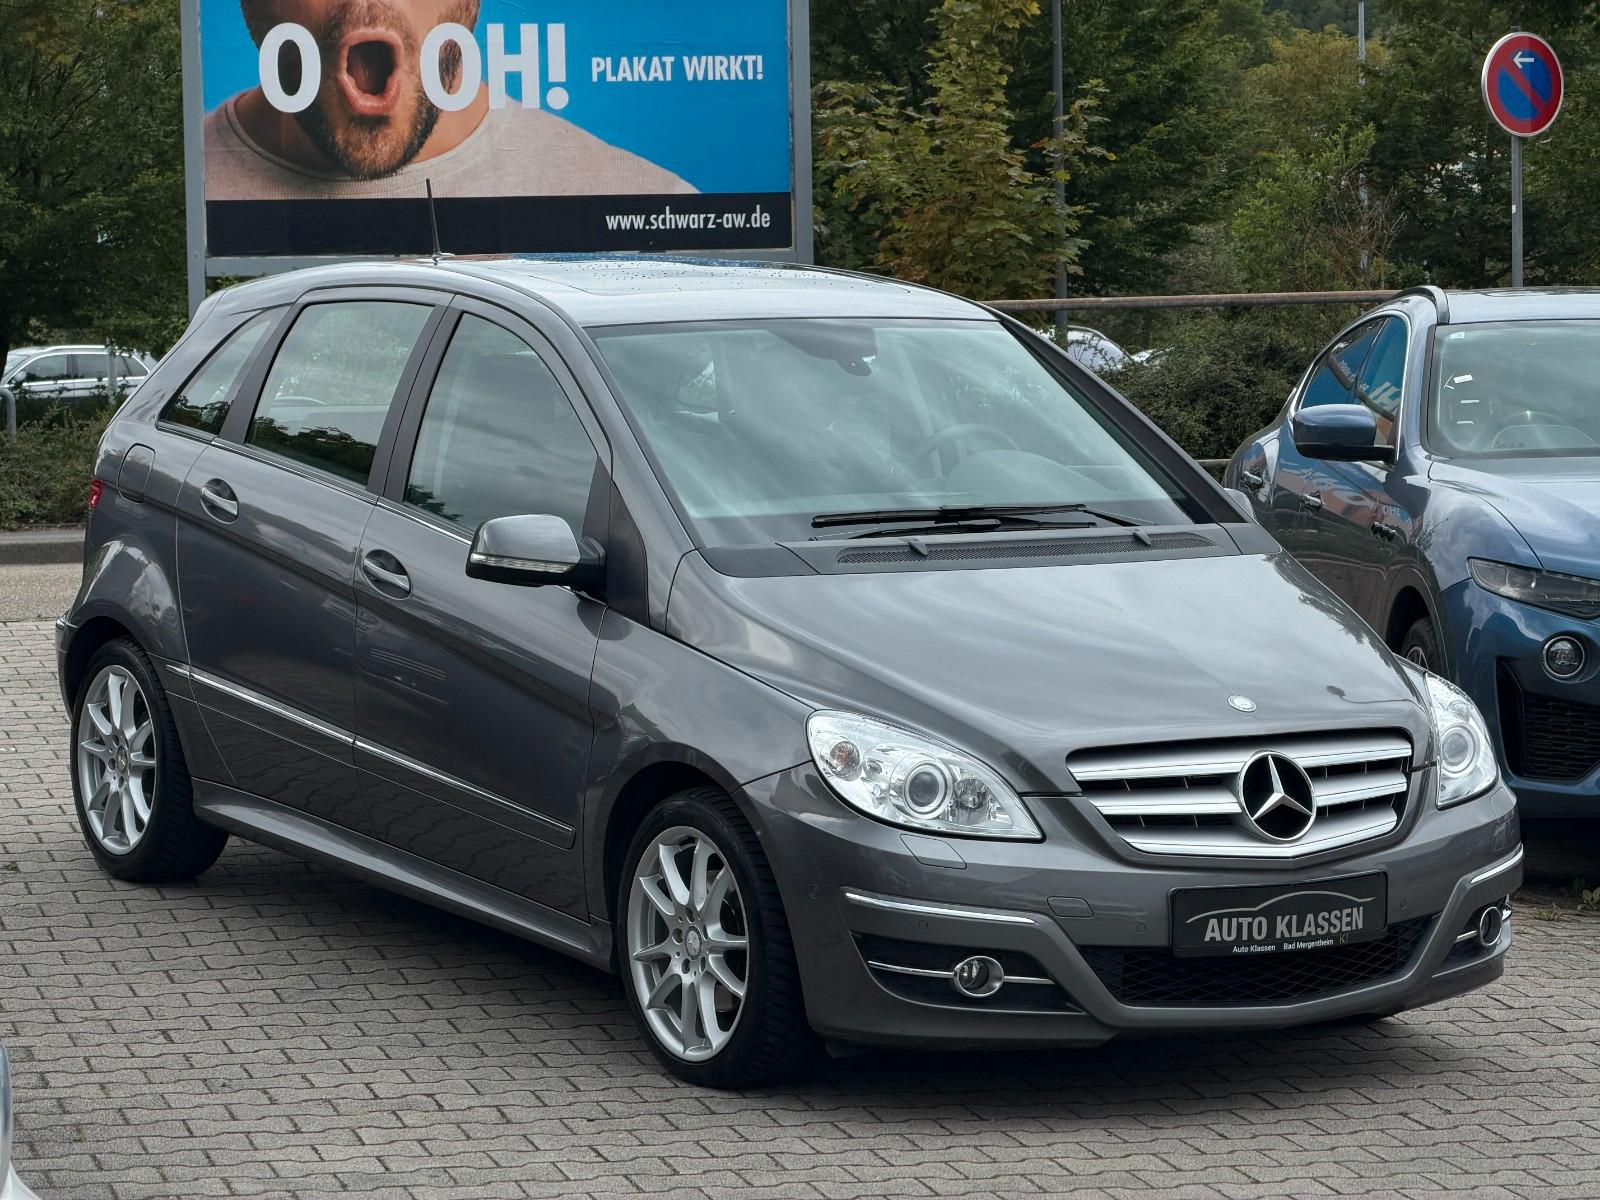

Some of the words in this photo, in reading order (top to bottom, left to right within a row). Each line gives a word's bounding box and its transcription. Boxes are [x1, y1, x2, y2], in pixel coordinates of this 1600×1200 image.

[591, 56, 675, 82] PLAKAT
[682, 55, 764, 81] WIRKT!
[606, 204, 771, 230] www.schwarz-aw.de
[1204, 917, 1268, 942] AUTO
[1275, 906, 1364, 939] KLASSEN
[1232, 945, 1249, 953] Auto
[1250, 944, 1276, 952] Klassen
[1283, 942, 1296, 950] Bad
[1297, 939, 1334, 949] Mergentheim
